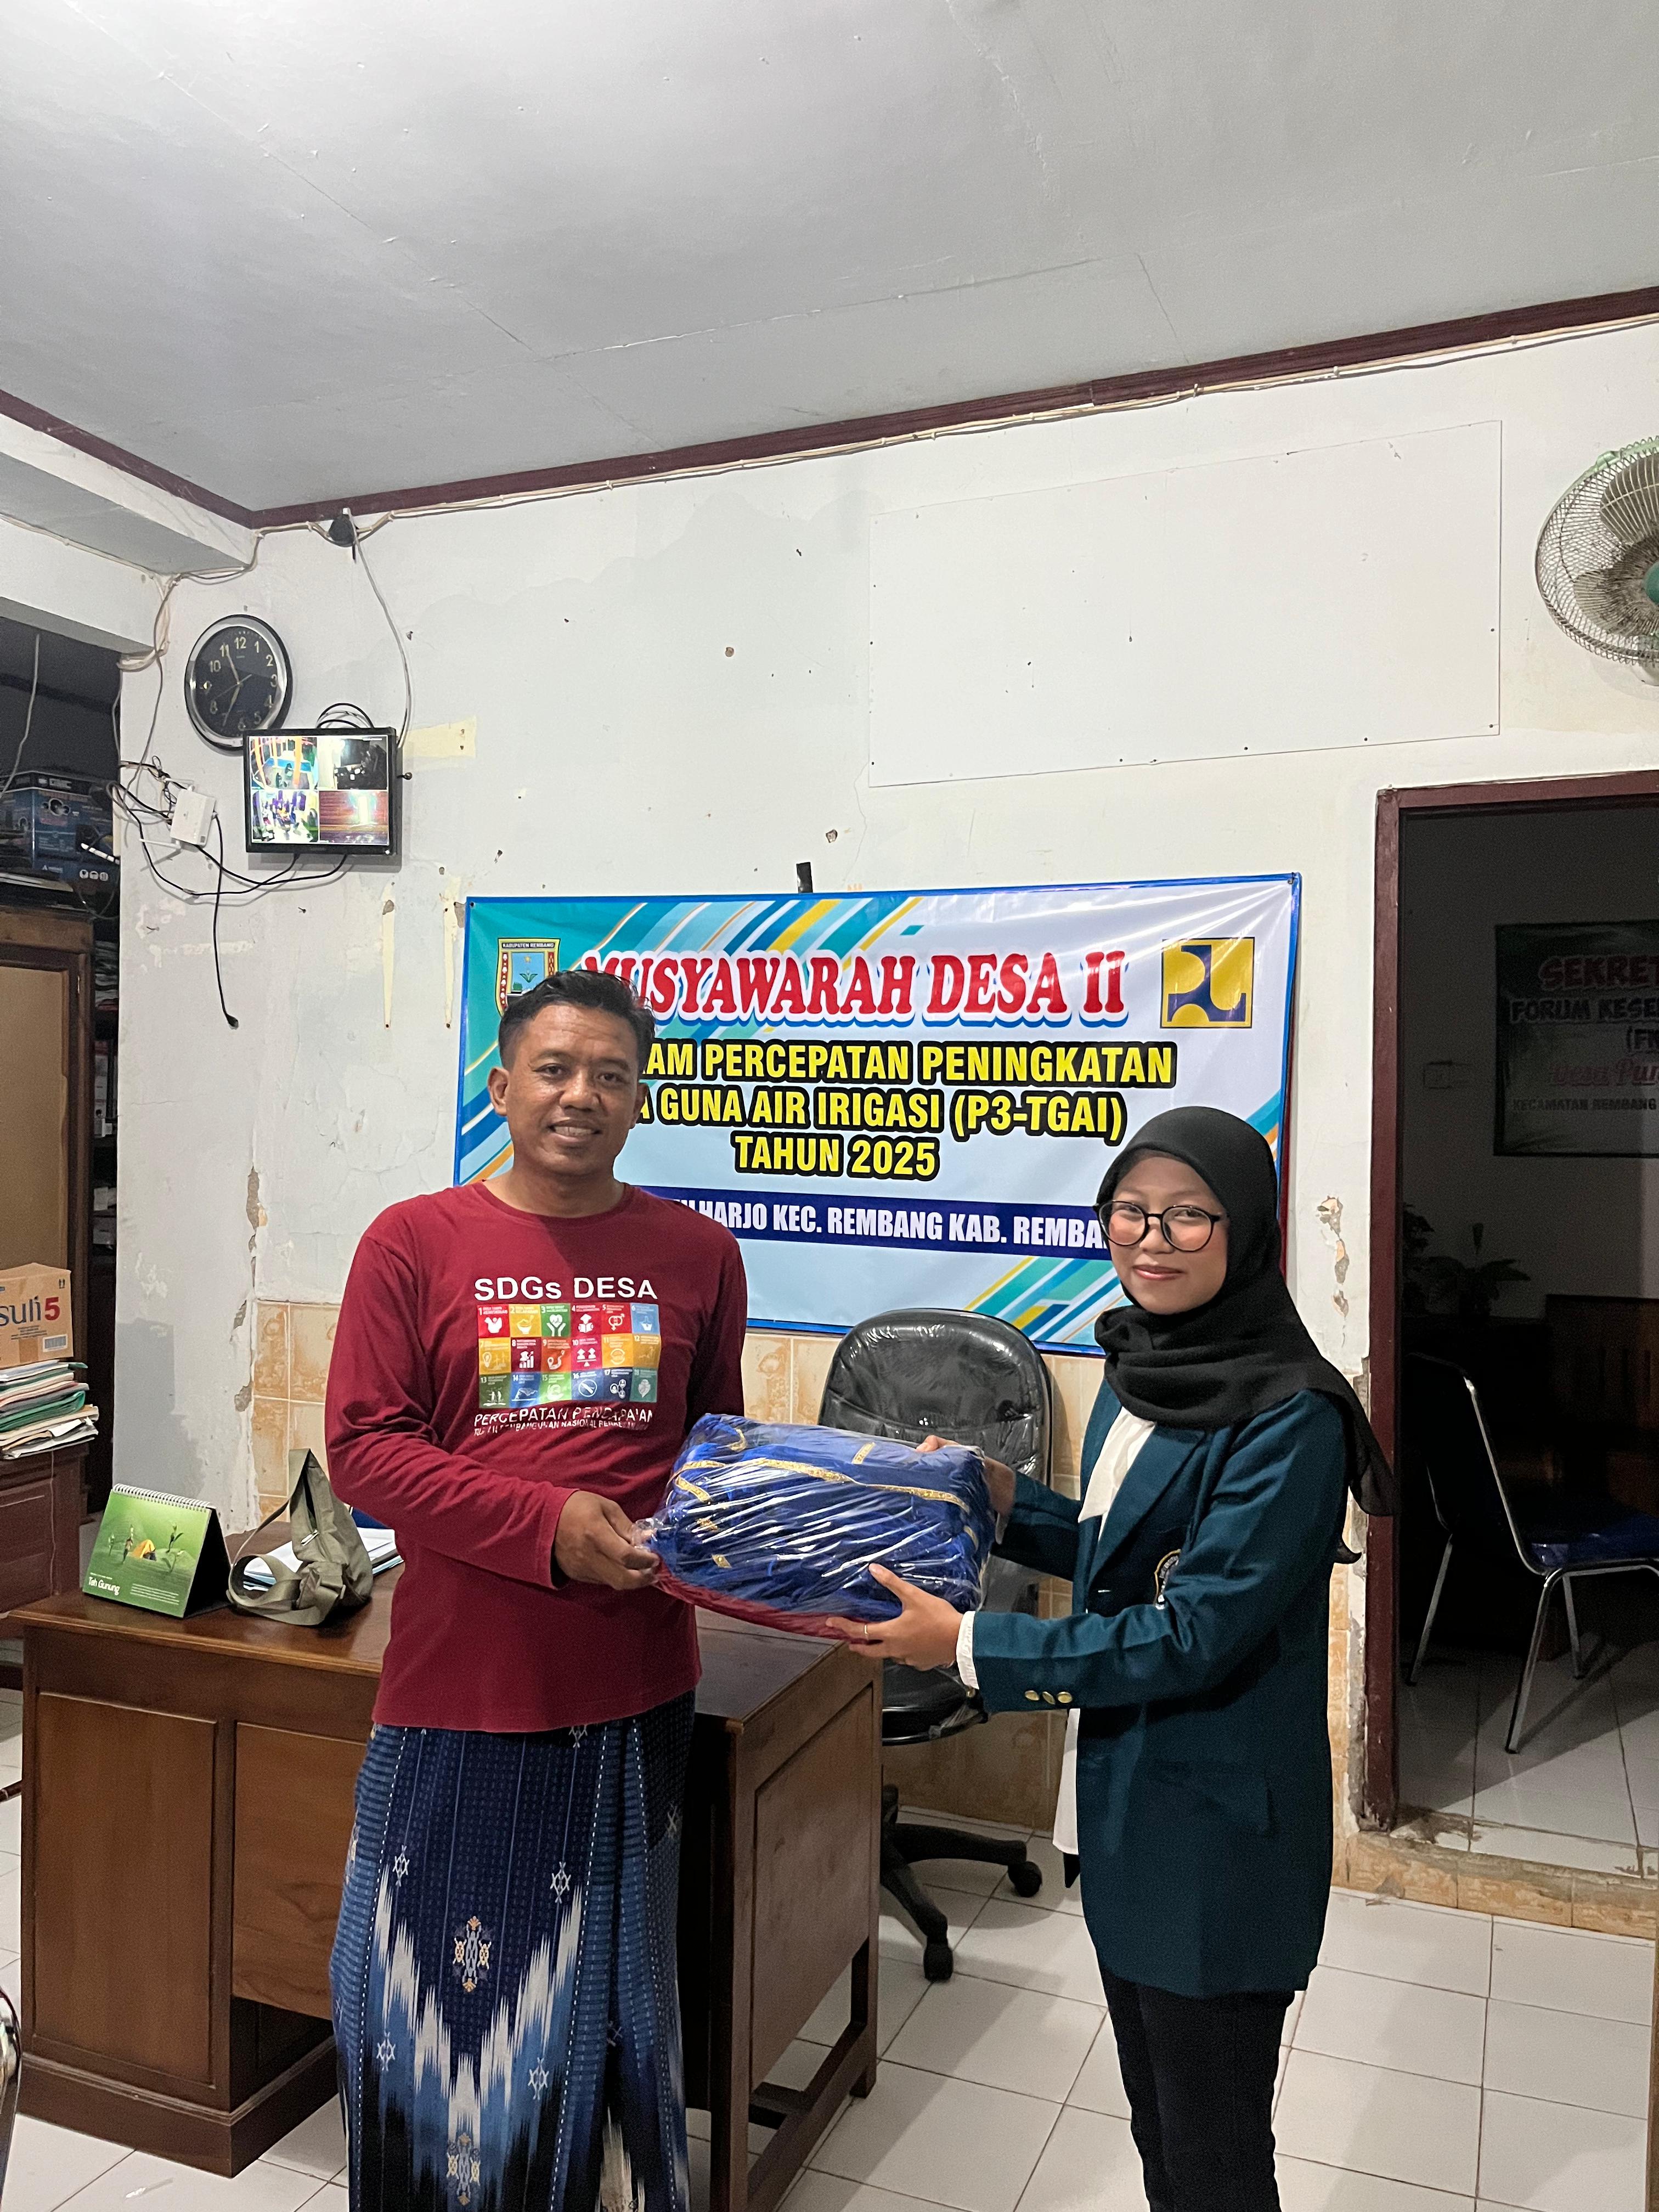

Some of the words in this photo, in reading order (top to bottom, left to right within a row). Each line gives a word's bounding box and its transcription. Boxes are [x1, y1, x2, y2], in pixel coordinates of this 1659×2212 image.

[234, 636, 246, 650] 12
[255, 641, 259, 653] 1
[210, 660, 221, 673] 10
[266, 654, 274, 667] 2
[270, 674, 277, 687] 3
[585, 956, 916, 1015] USYAWARAH
[927, 952, 1068, 1014] DESA
[1084, 950, 1125, 1014] II
[1512, 1000, 1590, 1021] FORUM
[706, 1044, 909, 1080] PERCEPATAN
[923, 1046, 1172, 1083] PENINGKATAN
[1513, 1098, 1588, 1111] KECAMATAN
[1592, 1098, 1656, 1110] REMBANG
[661, 1088, 743, 1122] GUNA
[753, 1091, 807, 1124] AIR
[818, 1092, 940, 1128] IRIGASI
[955, 1094, 1122, 1141] (P3-TGAI)
[735, 1136, 839, 1172] TAHUN
[851, 1139, 935, 1176] 2025
[773, 1204, 822, 1233] KEC.
[827, 1207, 943, 1240] REMBANG
[949, 1215, 1007, 1243] KAB.
[1013, 1216, 1107, 1249] REMBA
[475, 1276, 562, 1301] SDGs
[574, 1277, 658, 1300] DESA
[478, 1307, 482, 1315] 1
[98, 1579, 120, 1596] Gunung
